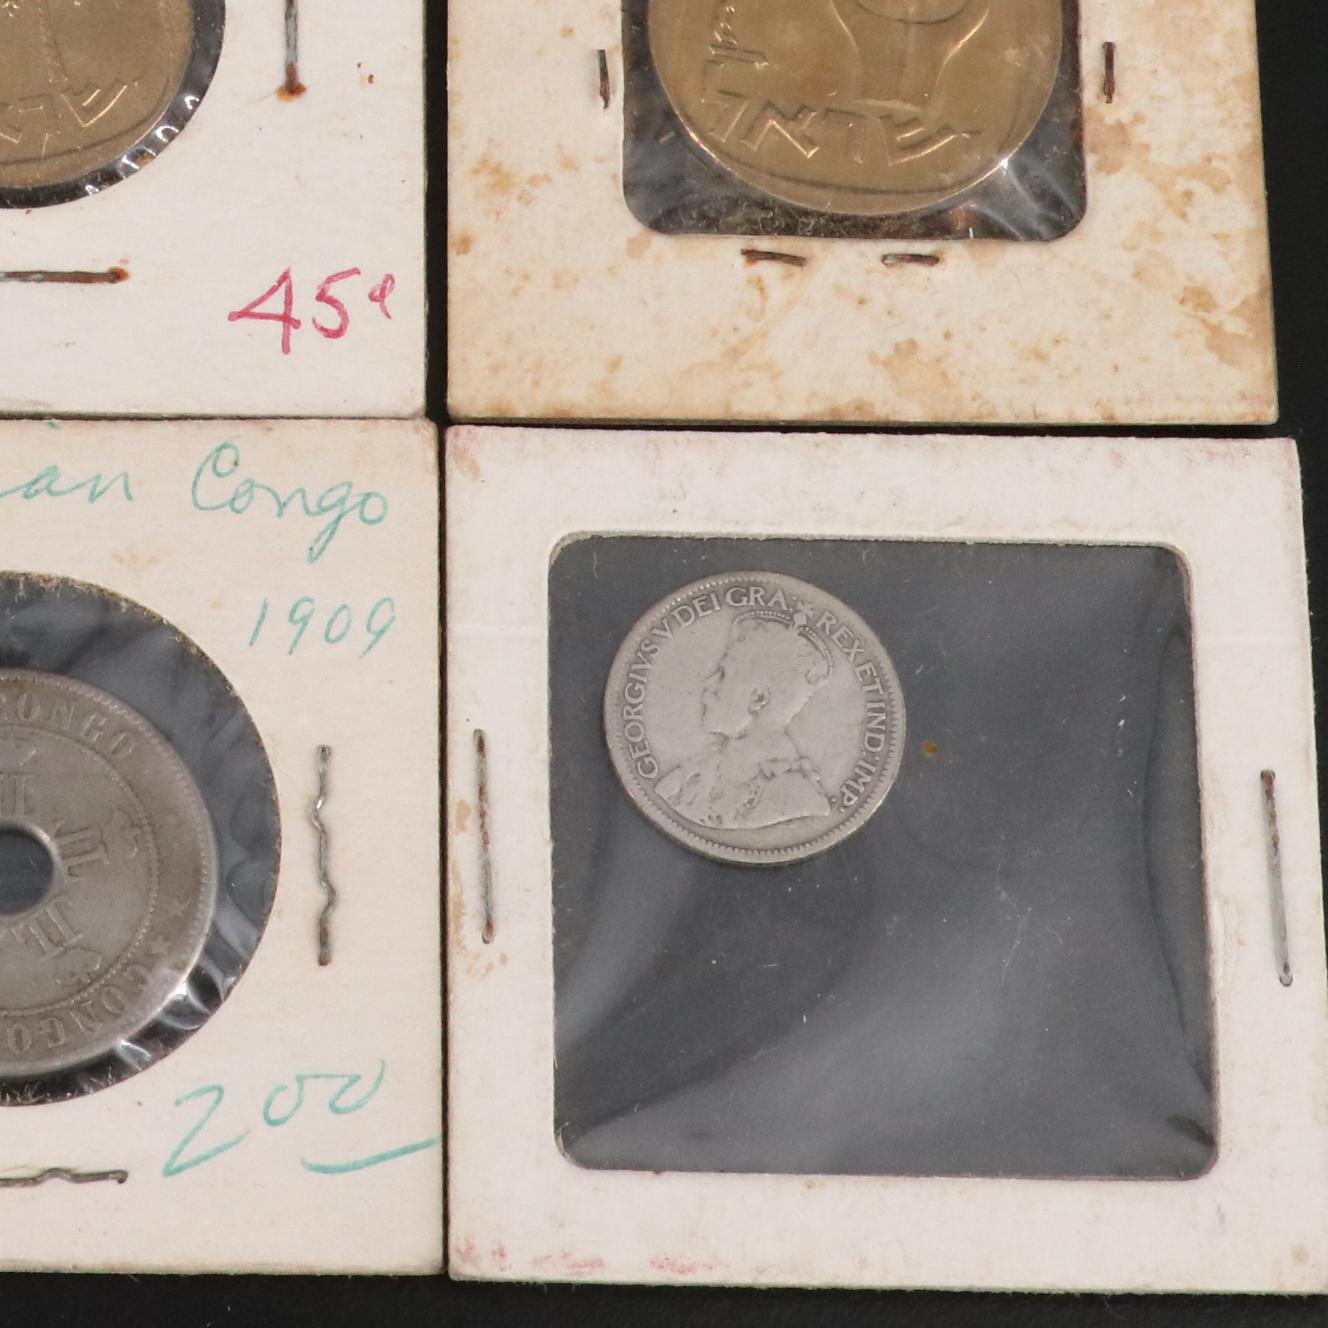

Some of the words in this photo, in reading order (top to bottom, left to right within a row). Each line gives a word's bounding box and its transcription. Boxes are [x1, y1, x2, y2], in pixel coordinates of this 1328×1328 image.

[189, 442, 390, 560] Congo
[248, 596, 397, 655] 1909
[623, 639, 660, 781] GEORGIVS
[671, 592, 721, 628] DEI
[815, 609, 866, 665] REX
